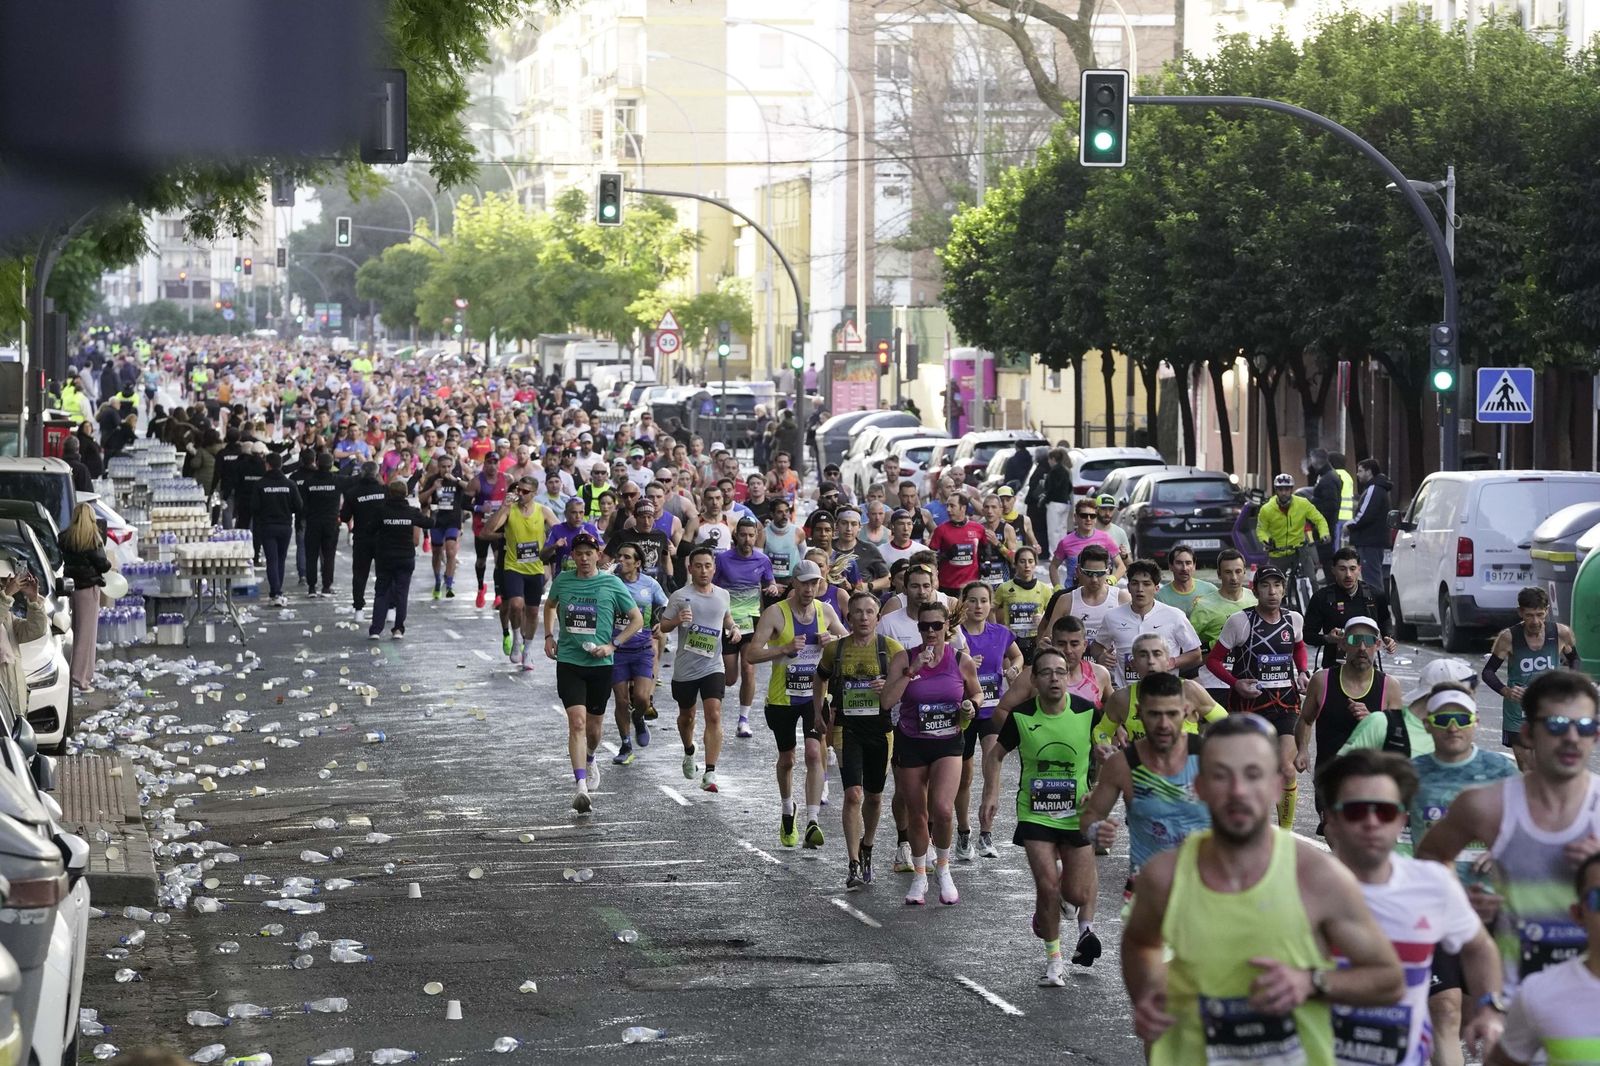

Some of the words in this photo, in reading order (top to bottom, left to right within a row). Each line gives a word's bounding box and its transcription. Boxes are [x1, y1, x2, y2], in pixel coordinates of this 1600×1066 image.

[662, 338, 675, 346] 30
[358, 494, 384, 502] VOLUNTEER
[1492, 572, 1514, 580] 9177
[1517, 572, 1534, 580] MFY
[688, 639, 714, 650] ALBERTO
[1262, 672, 1288, 680] EUGENIO
[926, 720, 952, 730] SOLÈNE
[1034, 800, 1072, 810] MARIANO
[1334, 1038, 1398, 1064] DAMIEN
